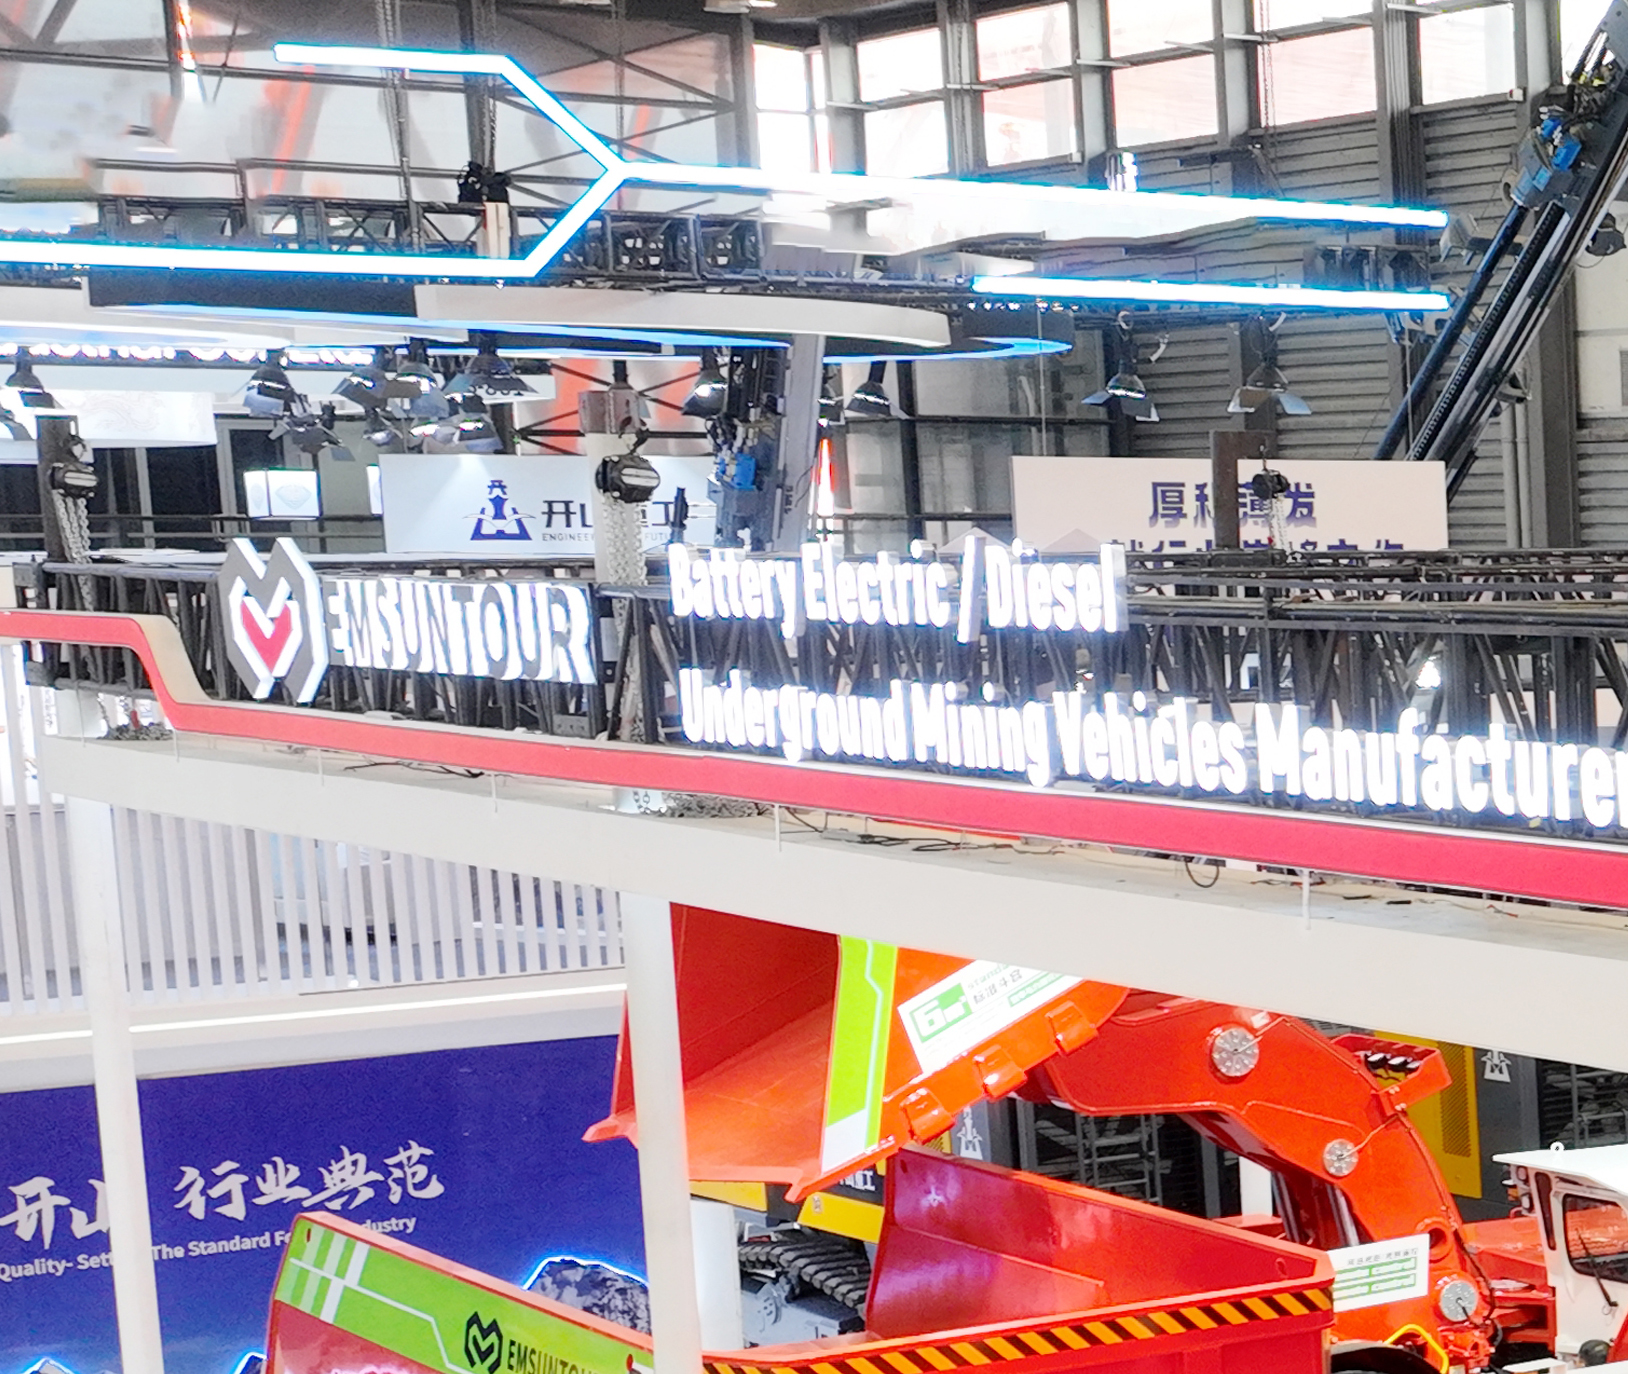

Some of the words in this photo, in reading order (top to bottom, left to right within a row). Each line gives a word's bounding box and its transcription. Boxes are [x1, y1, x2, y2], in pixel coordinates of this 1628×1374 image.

[327, 575, 599, 686] EMSUNTOUR
[668, 541, 798, 640] Battery
[801, 537, 951, 629] Electric
[680, 665, 902, 764] Underground
[912, 680, 1053, 788] Mining
[1053, 690, 1250, 796] Vehicles
[172, 1139, 446, 1222] 行业典范
[151, 1243, 185, 1263] The
[188, 1231, 271, 1257] Standard
